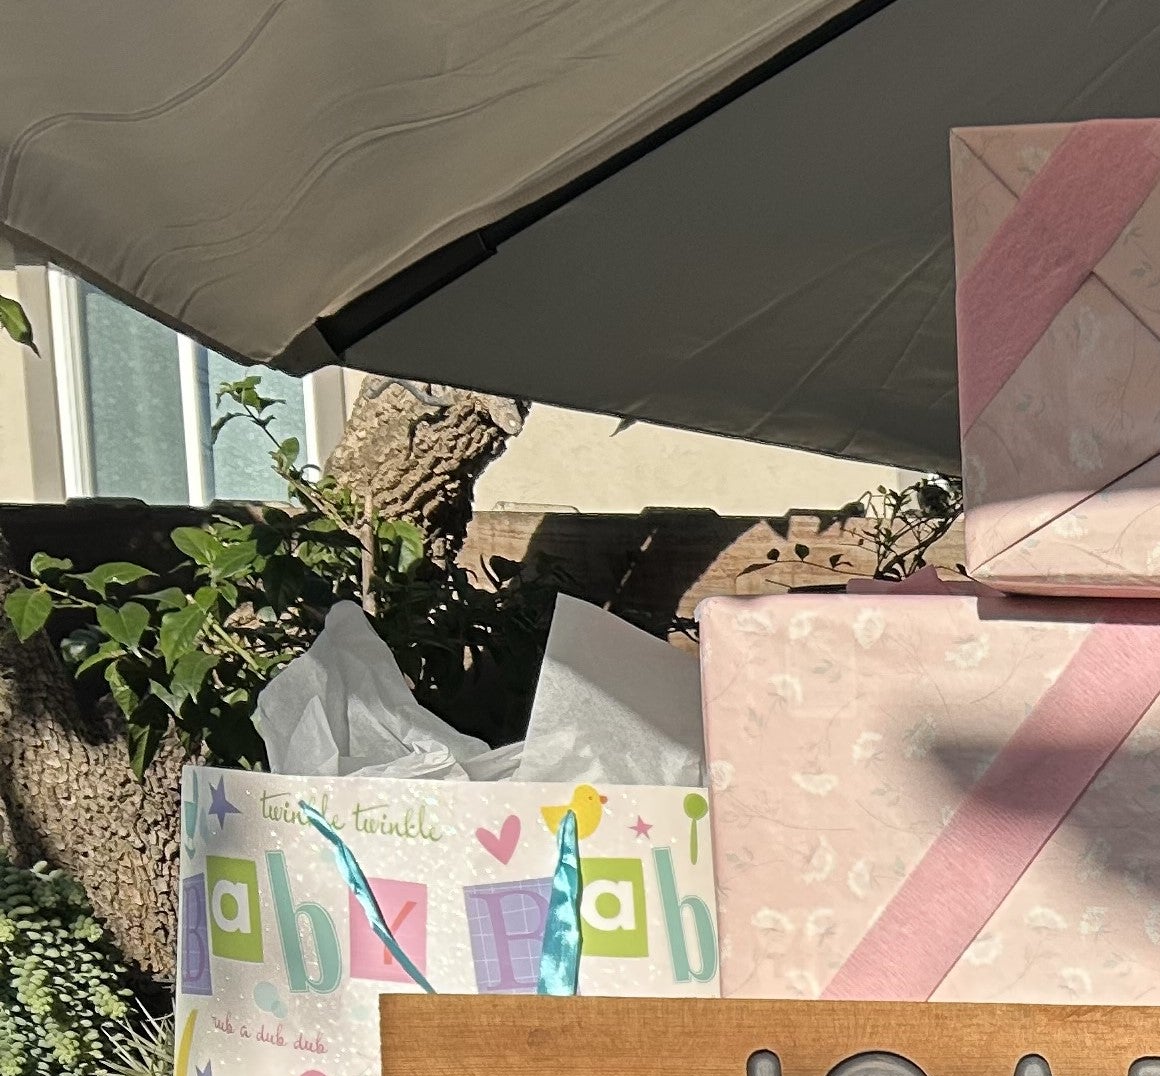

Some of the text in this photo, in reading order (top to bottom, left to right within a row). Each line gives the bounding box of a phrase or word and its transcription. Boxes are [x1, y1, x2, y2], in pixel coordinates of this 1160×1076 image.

[353, 802, 442, 841] twinkle
[240, 1025, 251, 1038] a
[256, 1023, 287, 1046] dub
[293, 1031, 329, 1054] dub
